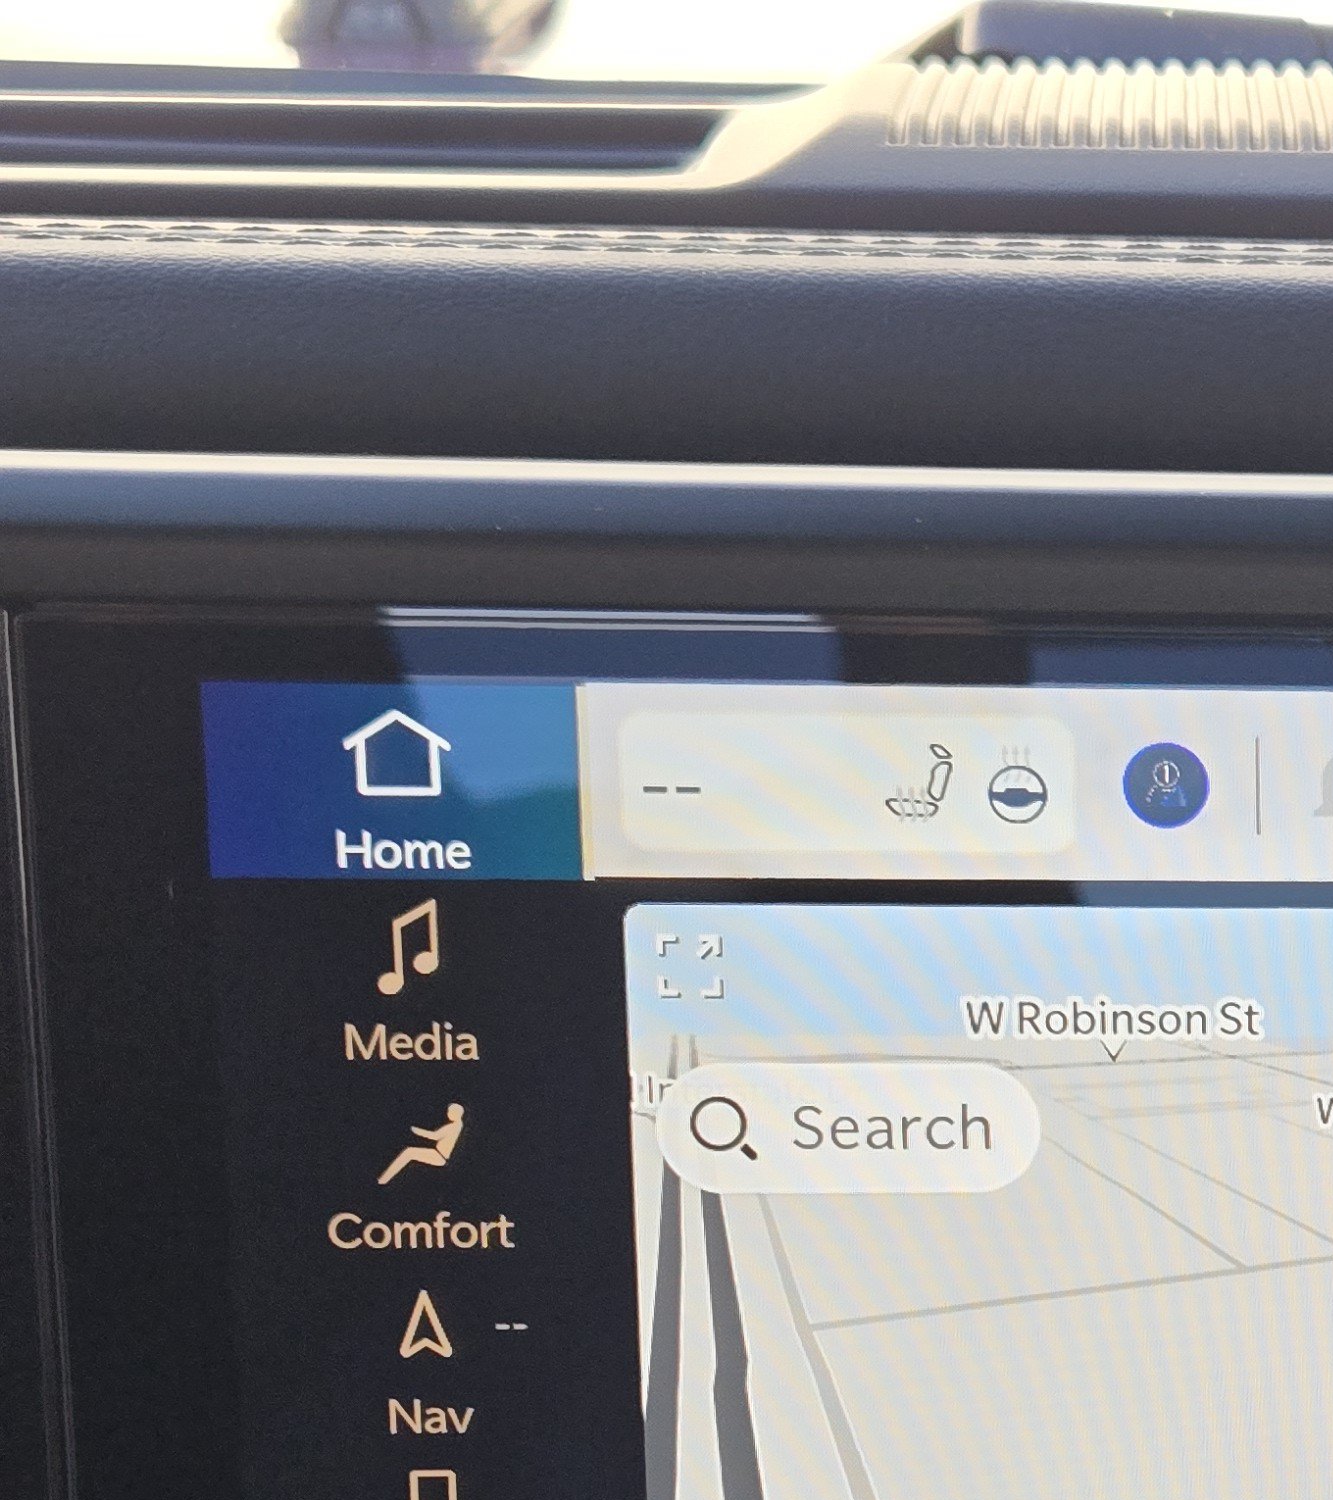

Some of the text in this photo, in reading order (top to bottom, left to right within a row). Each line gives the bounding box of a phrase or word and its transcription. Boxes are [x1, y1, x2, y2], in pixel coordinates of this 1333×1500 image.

[335, 829, 473, 870] Home
[966, 1001, 1260, 1037] W Robinson St
[343, 1023, 480, 1061] Media
[793, 1103, 993, 1150] Search
[327, 1211, 516, 1249] Comfort
[387, 1399, 475, 1436] Nav
